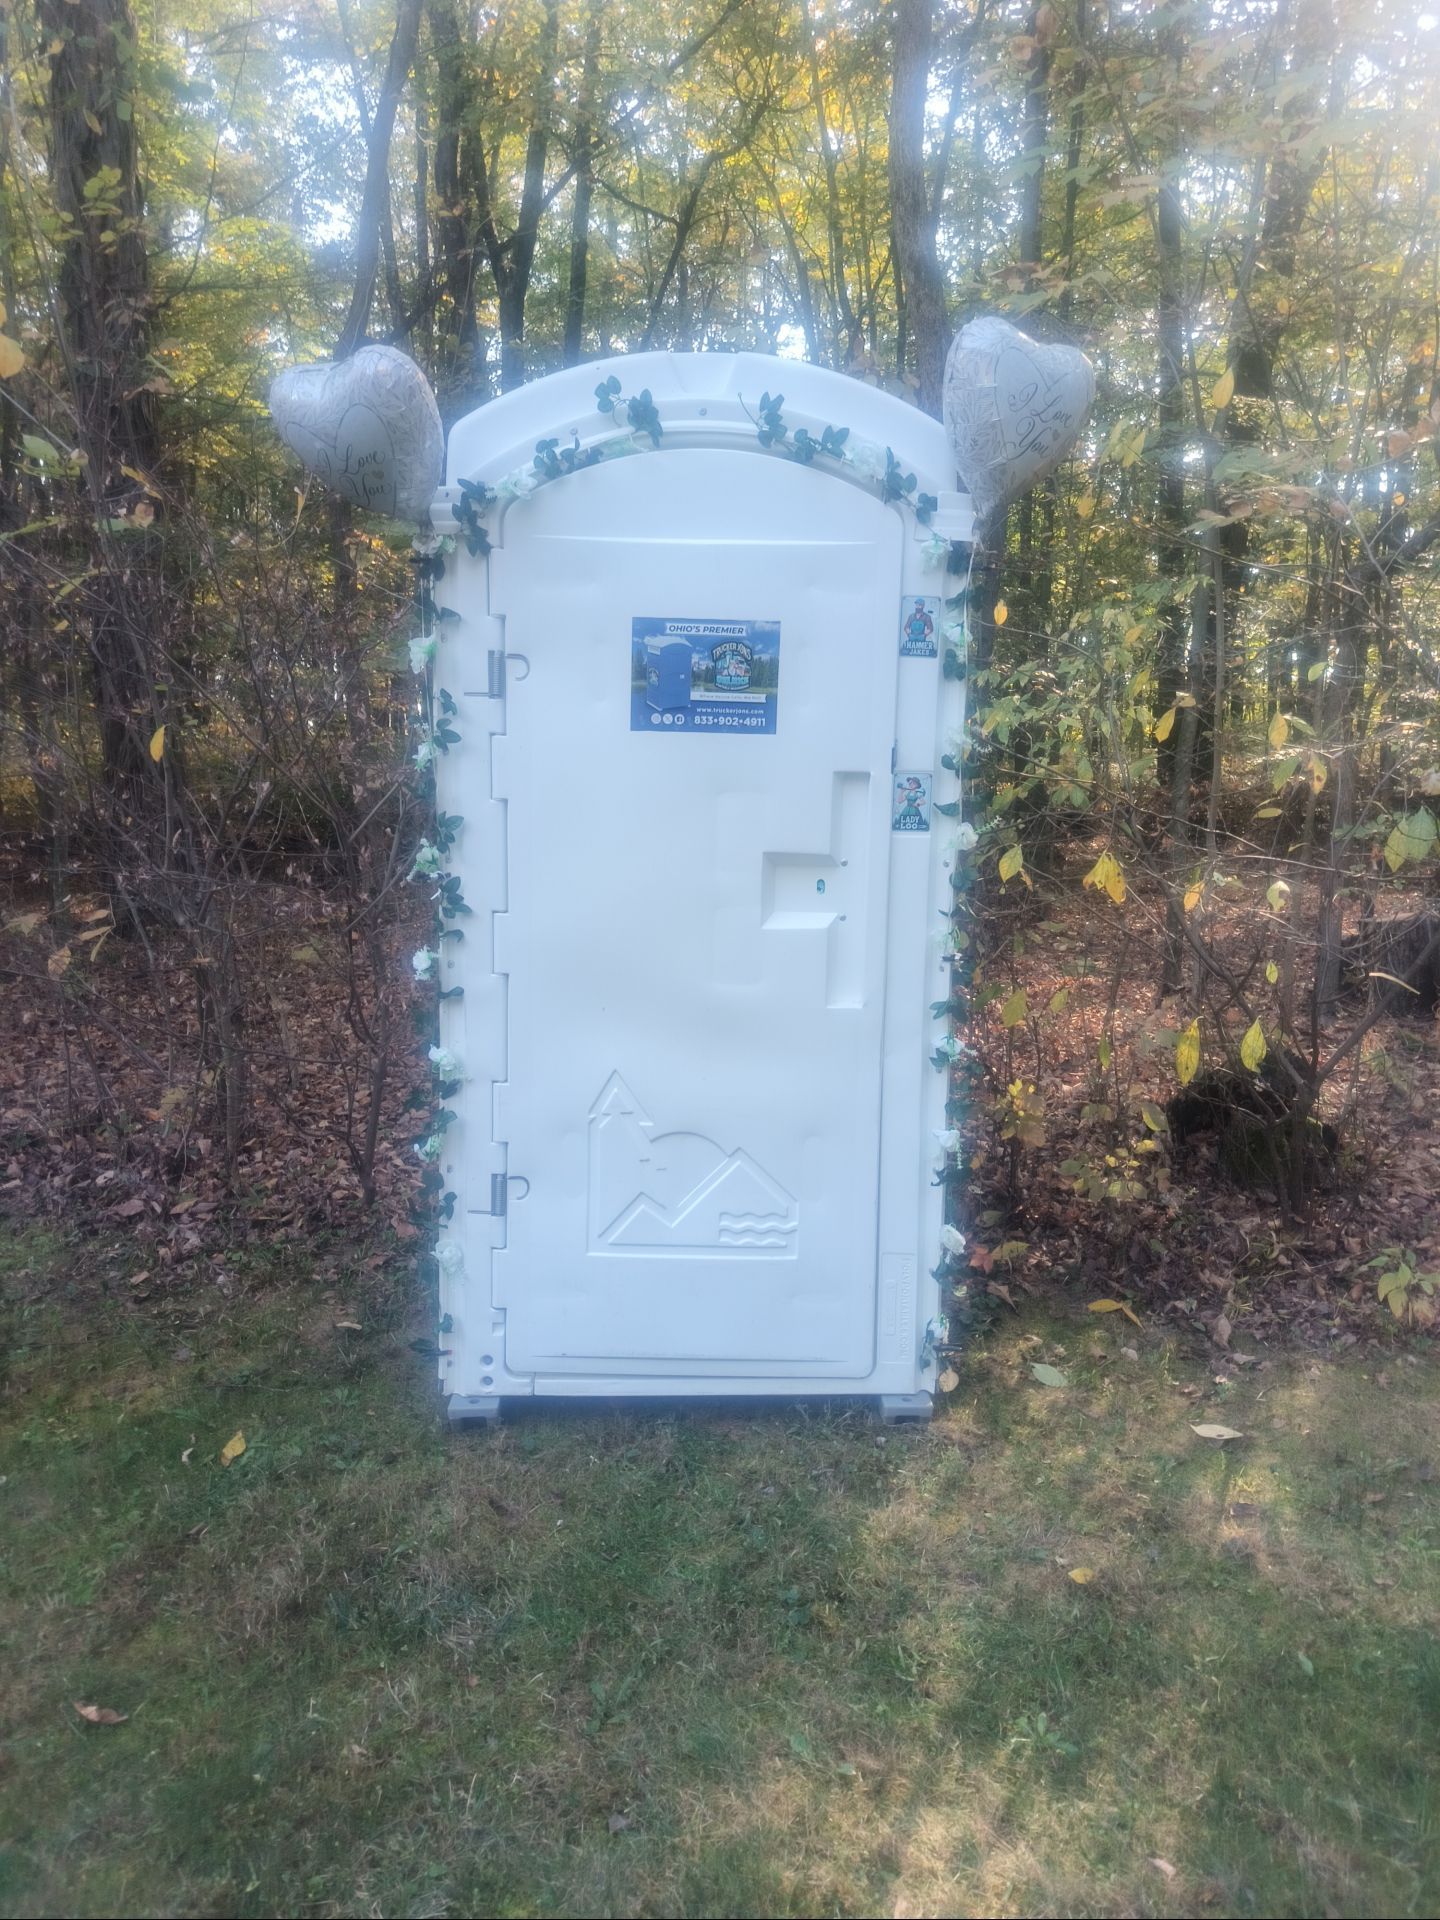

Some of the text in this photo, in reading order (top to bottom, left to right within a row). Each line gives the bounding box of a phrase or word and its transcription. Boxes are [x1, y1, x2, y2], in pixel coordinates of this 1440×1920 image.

[1030, 395, 1073, 428] Love
[1001, 416, 1053, 461] You
[338, 444, 385, 475] Love
[339, 472, 392, 507] You
[668, 624, 744, 635] OHIO'S PREMIER
[713, 643, 737, 660] TRUCKER
[696, 707, 764, 715] www.truckerjons.com
[900, 815, 920, 823] LADY
